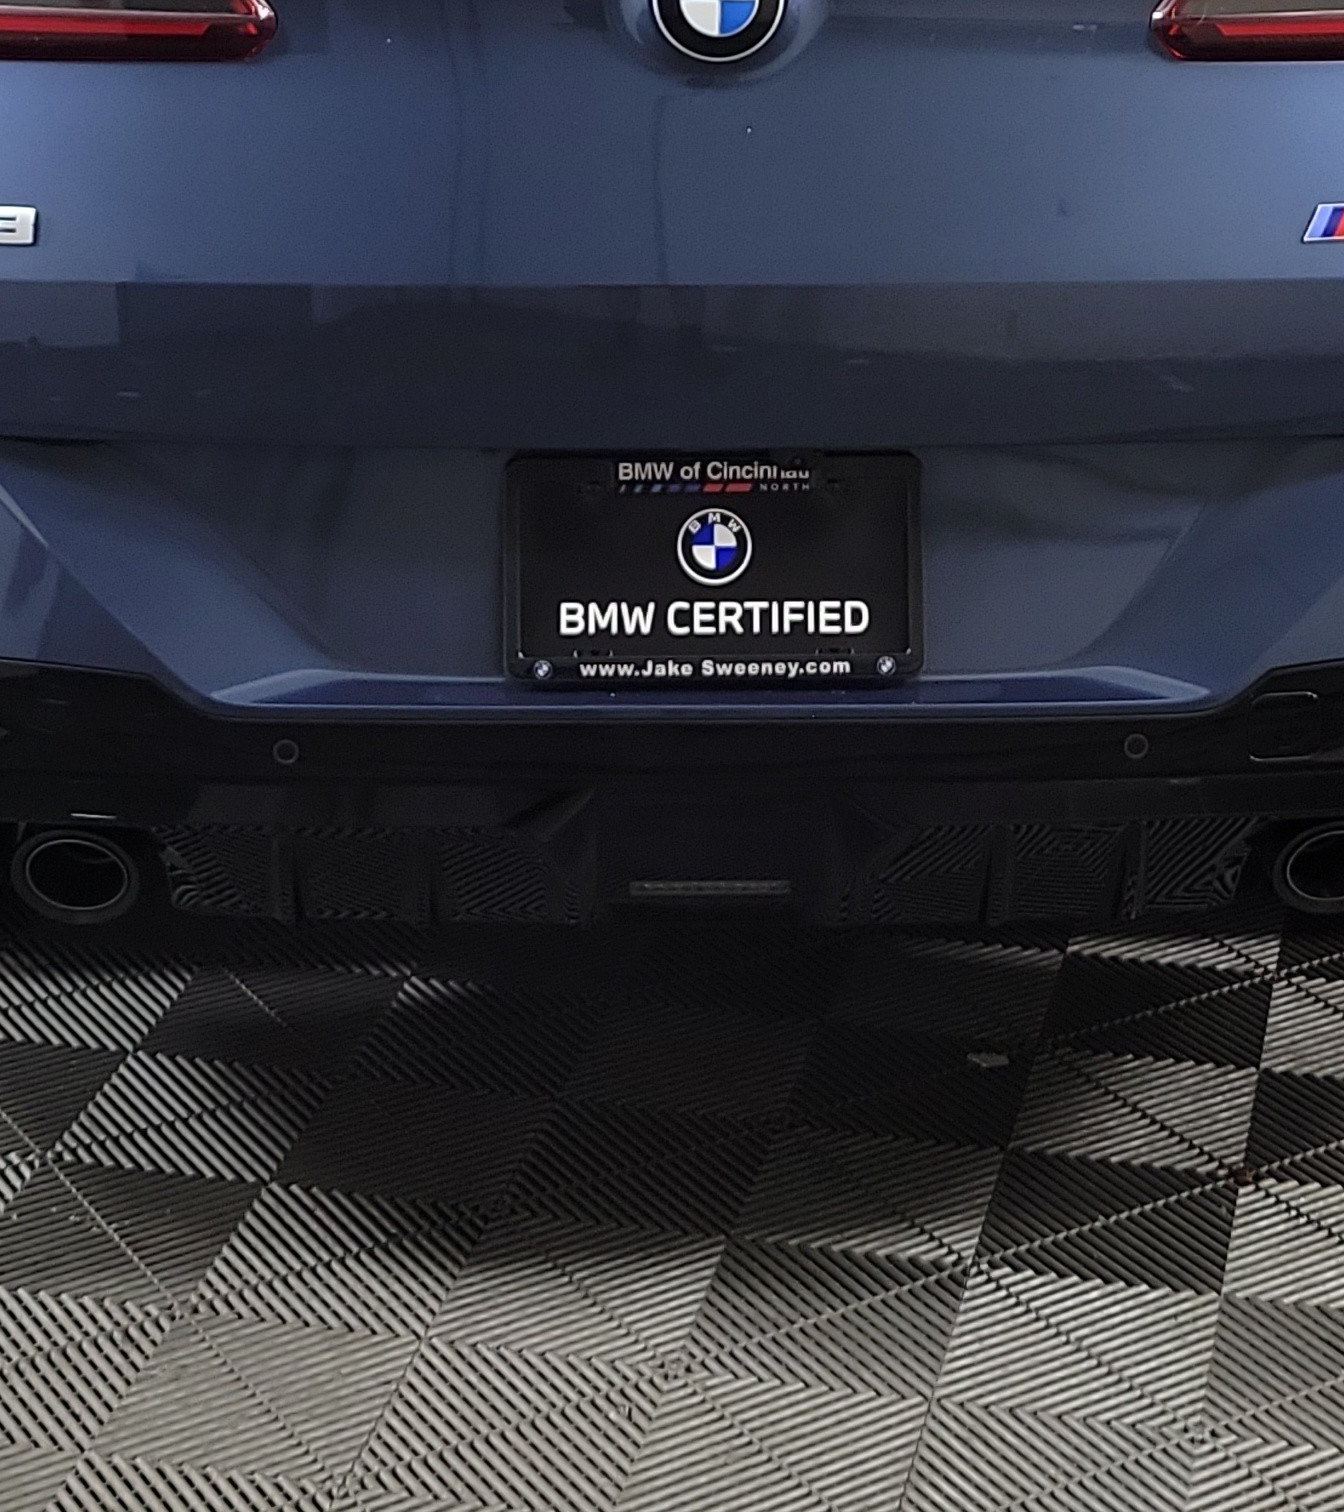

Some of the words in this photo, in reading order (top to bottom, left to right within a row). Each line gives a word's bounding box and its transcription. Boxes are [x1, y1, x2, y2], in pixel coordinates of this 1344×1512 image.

[618, 462, 674, 481] BMW
[680, 461, 701, 480] of
[759, 483, 810, 492] NORTH
[688, 512, 741, 533] BMW
[559, 600, 655, 636] BMW
[667, 599, 869, 636] CERTIFIED
[579, 659, 693, 677] www.Jake
[701, 659, 851, 678] Sweeney.com
